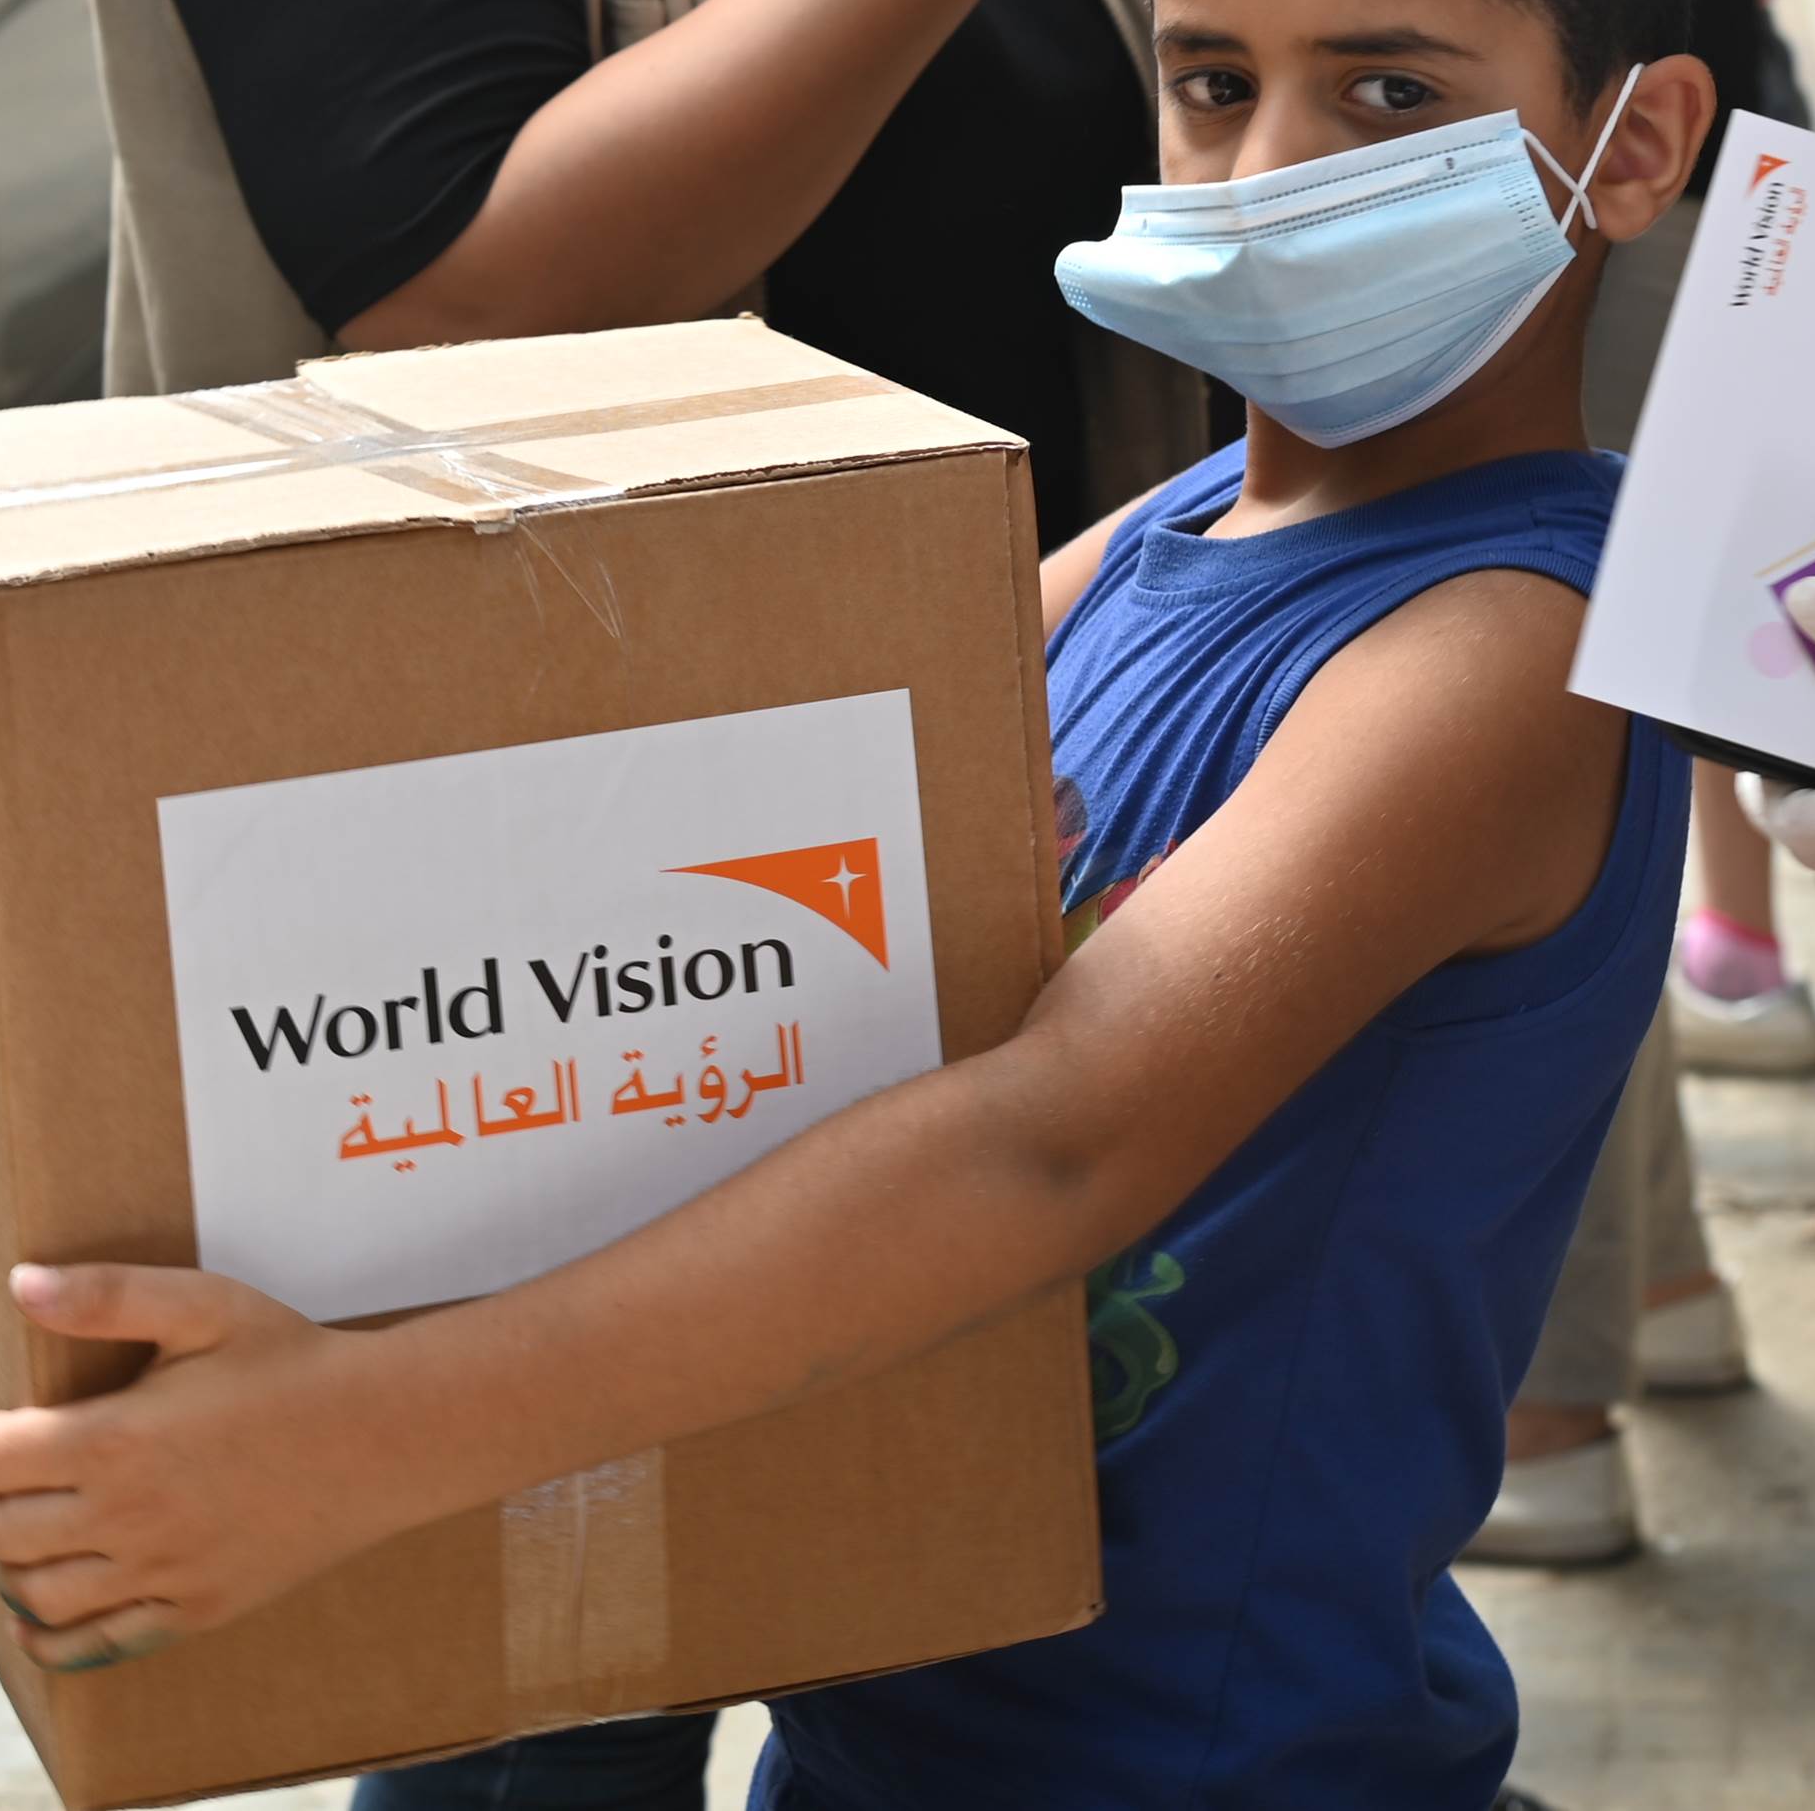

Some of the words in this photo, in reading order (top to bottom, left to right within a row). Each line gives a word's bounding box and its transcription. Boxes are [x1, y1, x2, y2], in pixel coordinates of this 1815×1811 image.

[1729, 246, 1765, 307] World
[1751, 182, 1785, 240] Vision
[229, 956, 505, 1073] World
[528, 934, 796, 1024] Vision
[338, 1057, 582, 1173] العالمية
[610, 1021, 806, 1128] الرؤية
